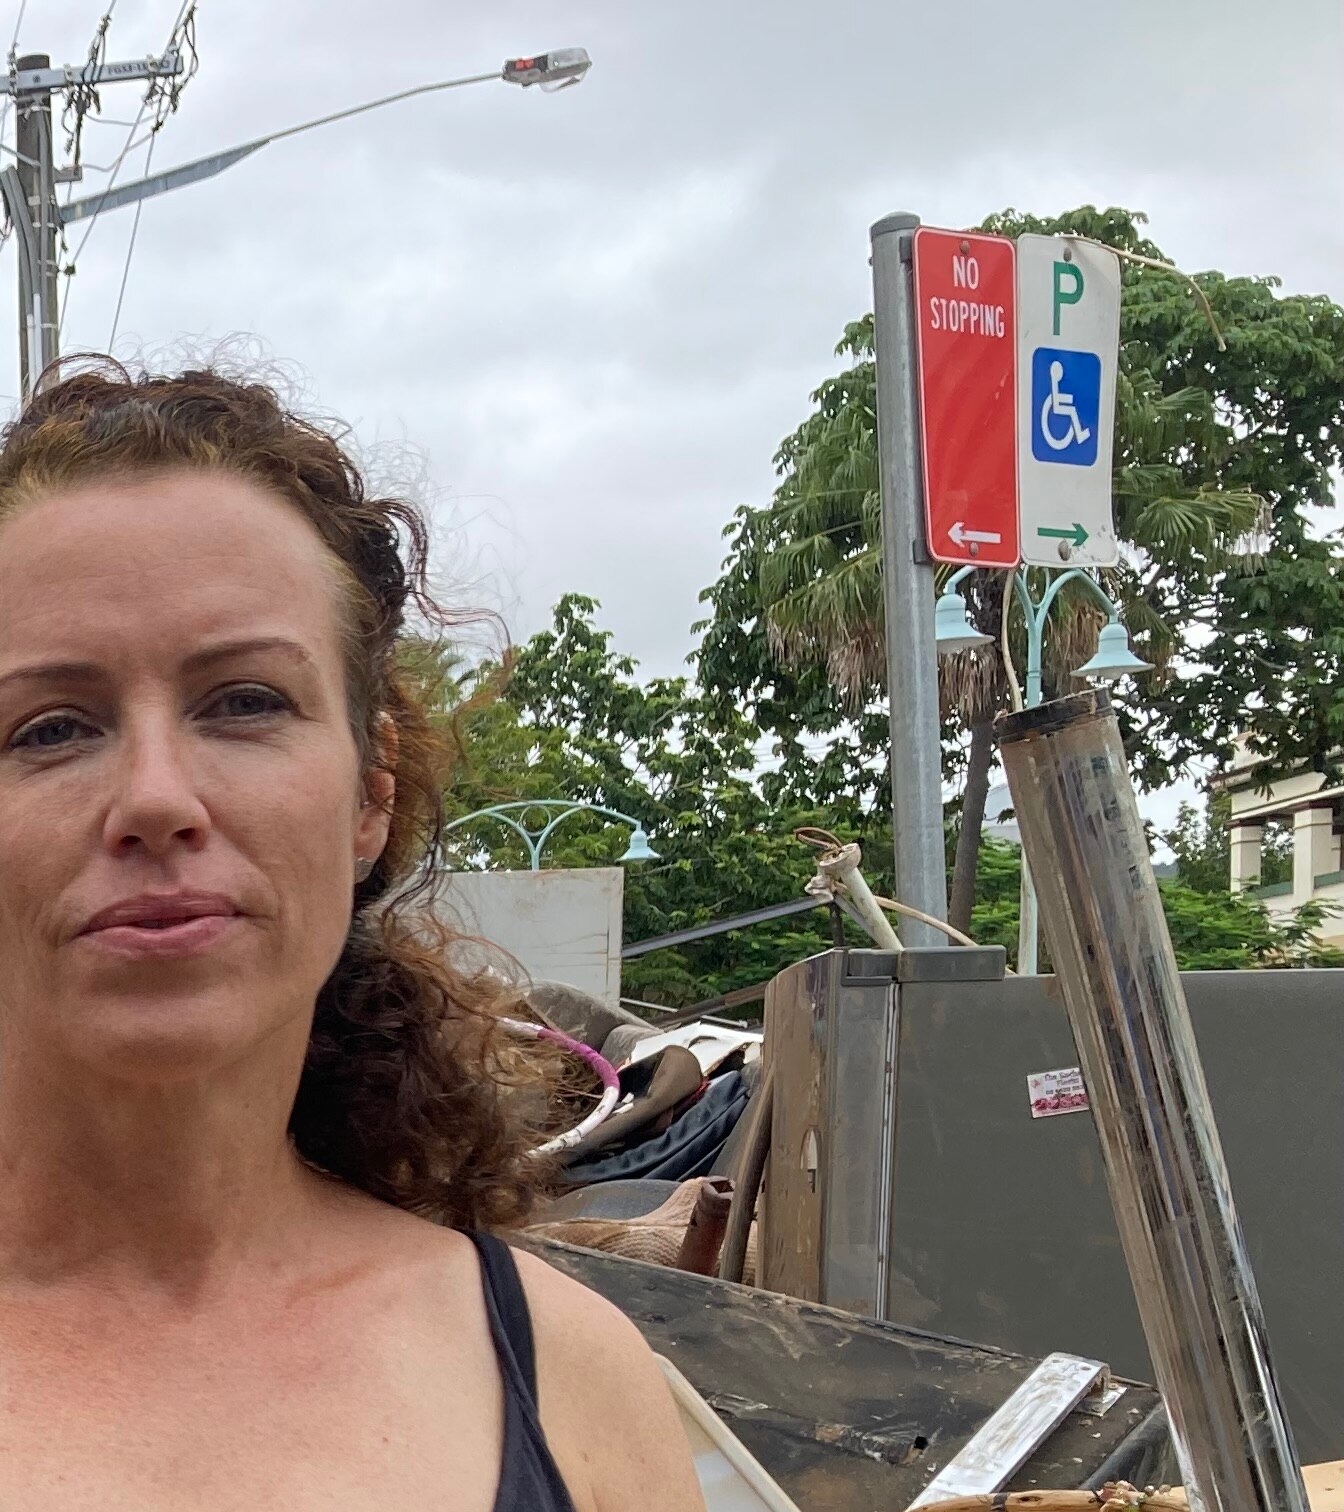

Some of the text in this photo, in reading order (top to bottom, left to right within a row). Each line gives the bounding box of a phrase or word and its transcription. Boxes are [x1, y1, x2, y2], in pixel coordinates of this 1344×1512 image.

[953, 255, 979, 290] NO
[930, 297, 1005, 338] STOPPING
[1053, 261, 1084, 336] P
